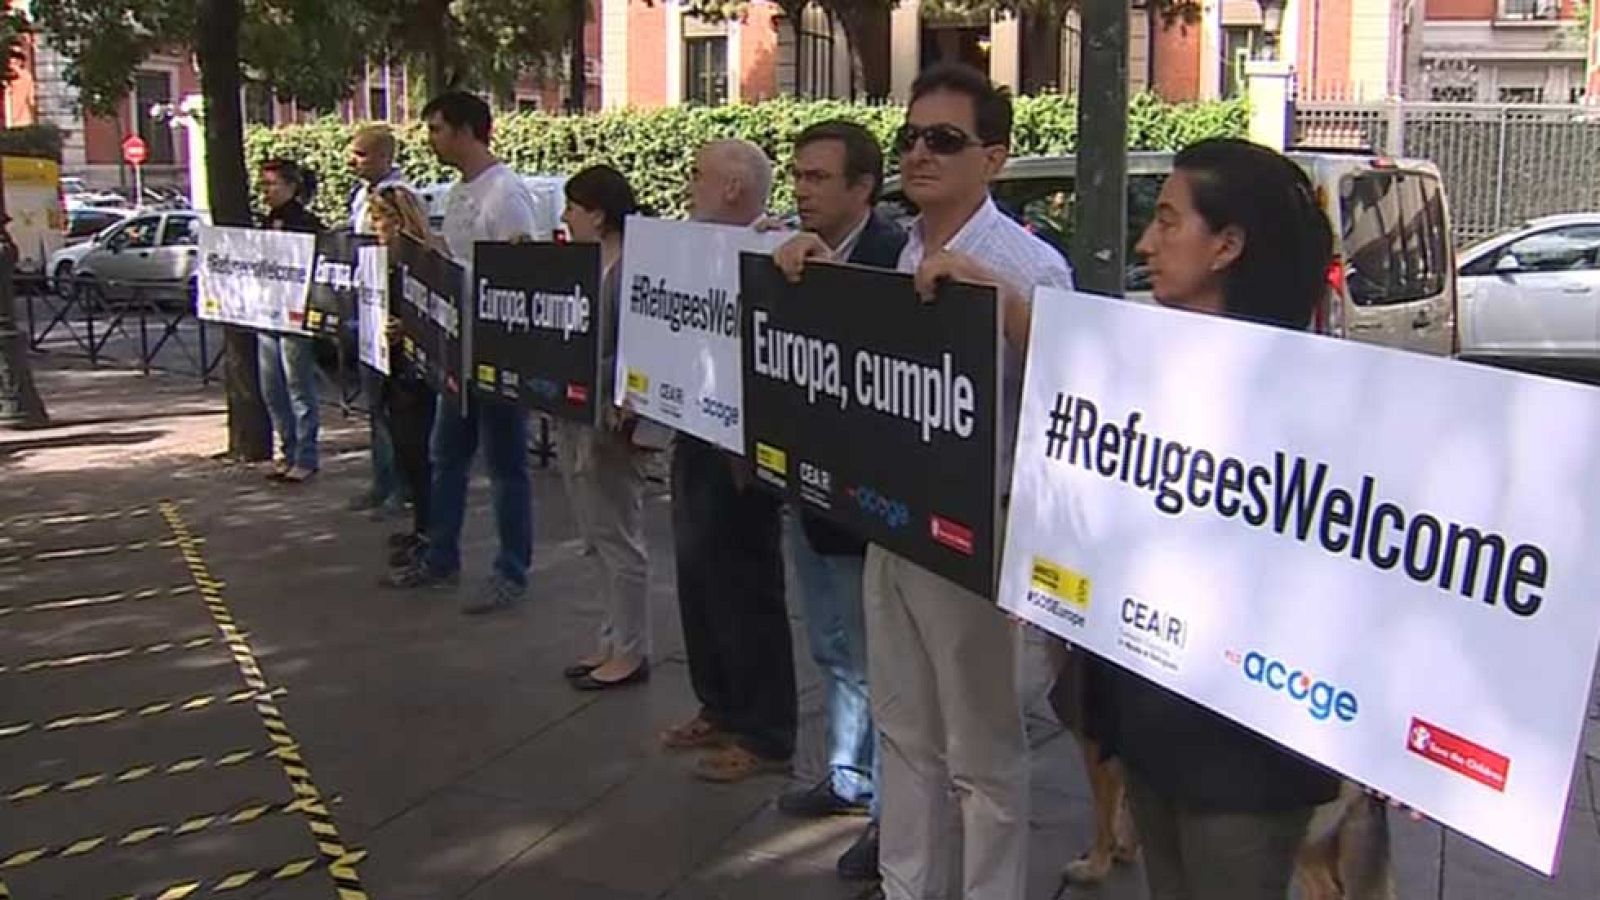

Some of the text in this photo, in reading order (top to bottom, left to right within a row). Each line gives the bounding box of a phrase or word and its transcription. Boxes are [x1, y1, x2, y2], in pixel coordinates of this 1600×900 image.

[479, 277, 590, 341] Europa, cumple
[753, 309, 974, 442] Europa, cumple
[1045, 391, 1549, 618] #RefugeesWelcome
[1243, 650, 1359, 723] acoge
